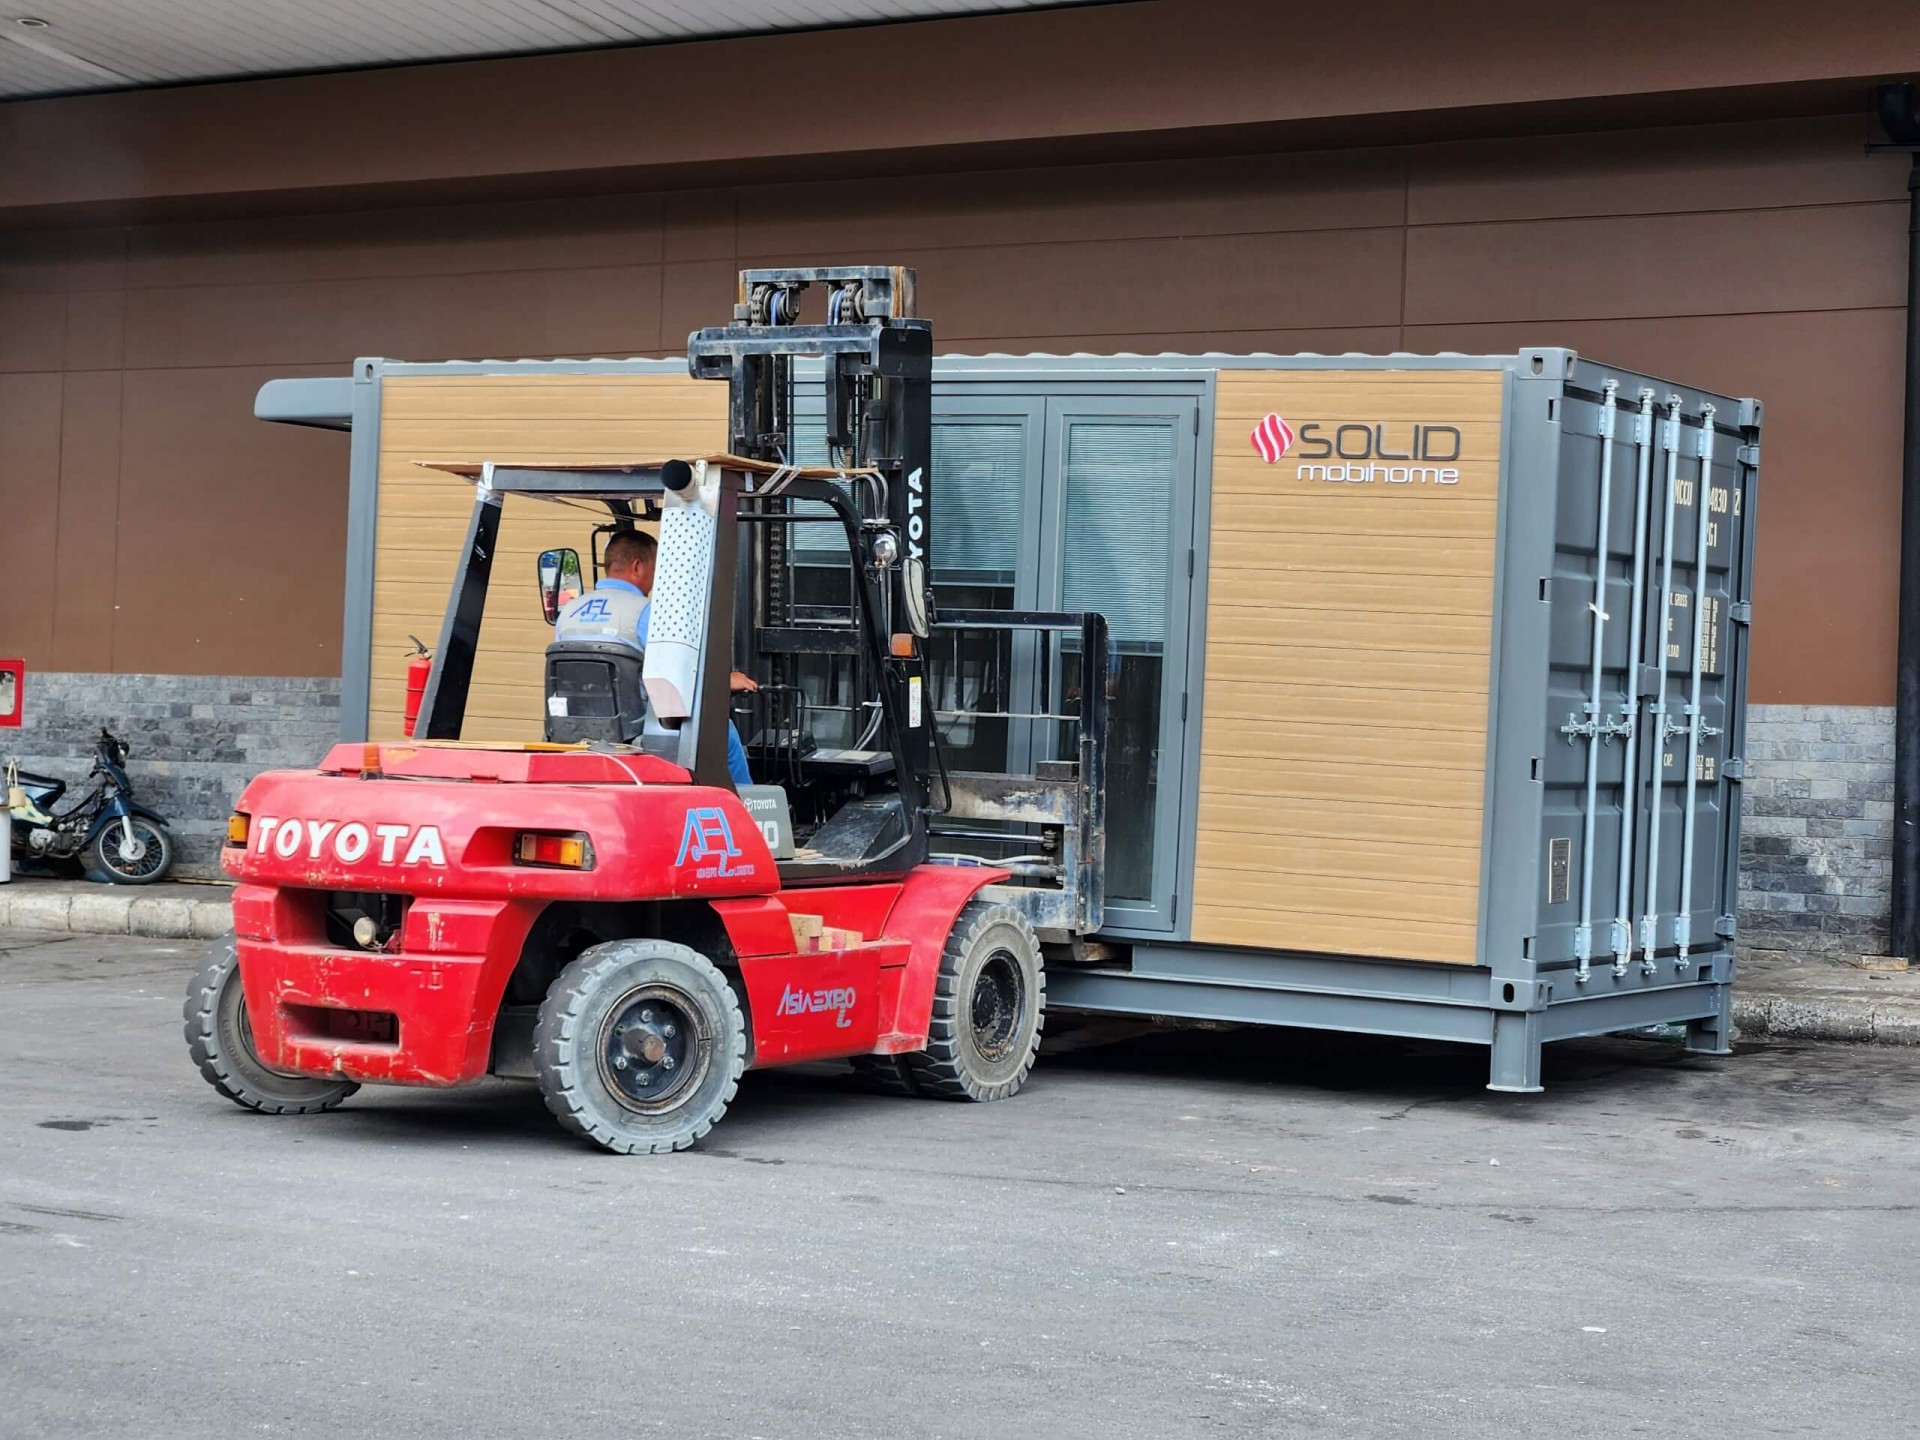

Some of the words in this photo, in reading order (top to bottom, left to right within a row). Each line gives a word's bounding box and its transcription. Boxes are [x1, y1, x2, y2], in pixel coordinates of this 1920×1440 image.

[1298, 424, 1461, 461] SOLID
[1296, 462, 1459, 485] mobihome
[907, 466, 923, 559] YOTA
[1709, 487, 1728, 514] 4830
[1706, 522, 1718, 548] G1
[753, 798, 778, 811] TOYOTA
[256, 817, 447, 866] TOYOTA
